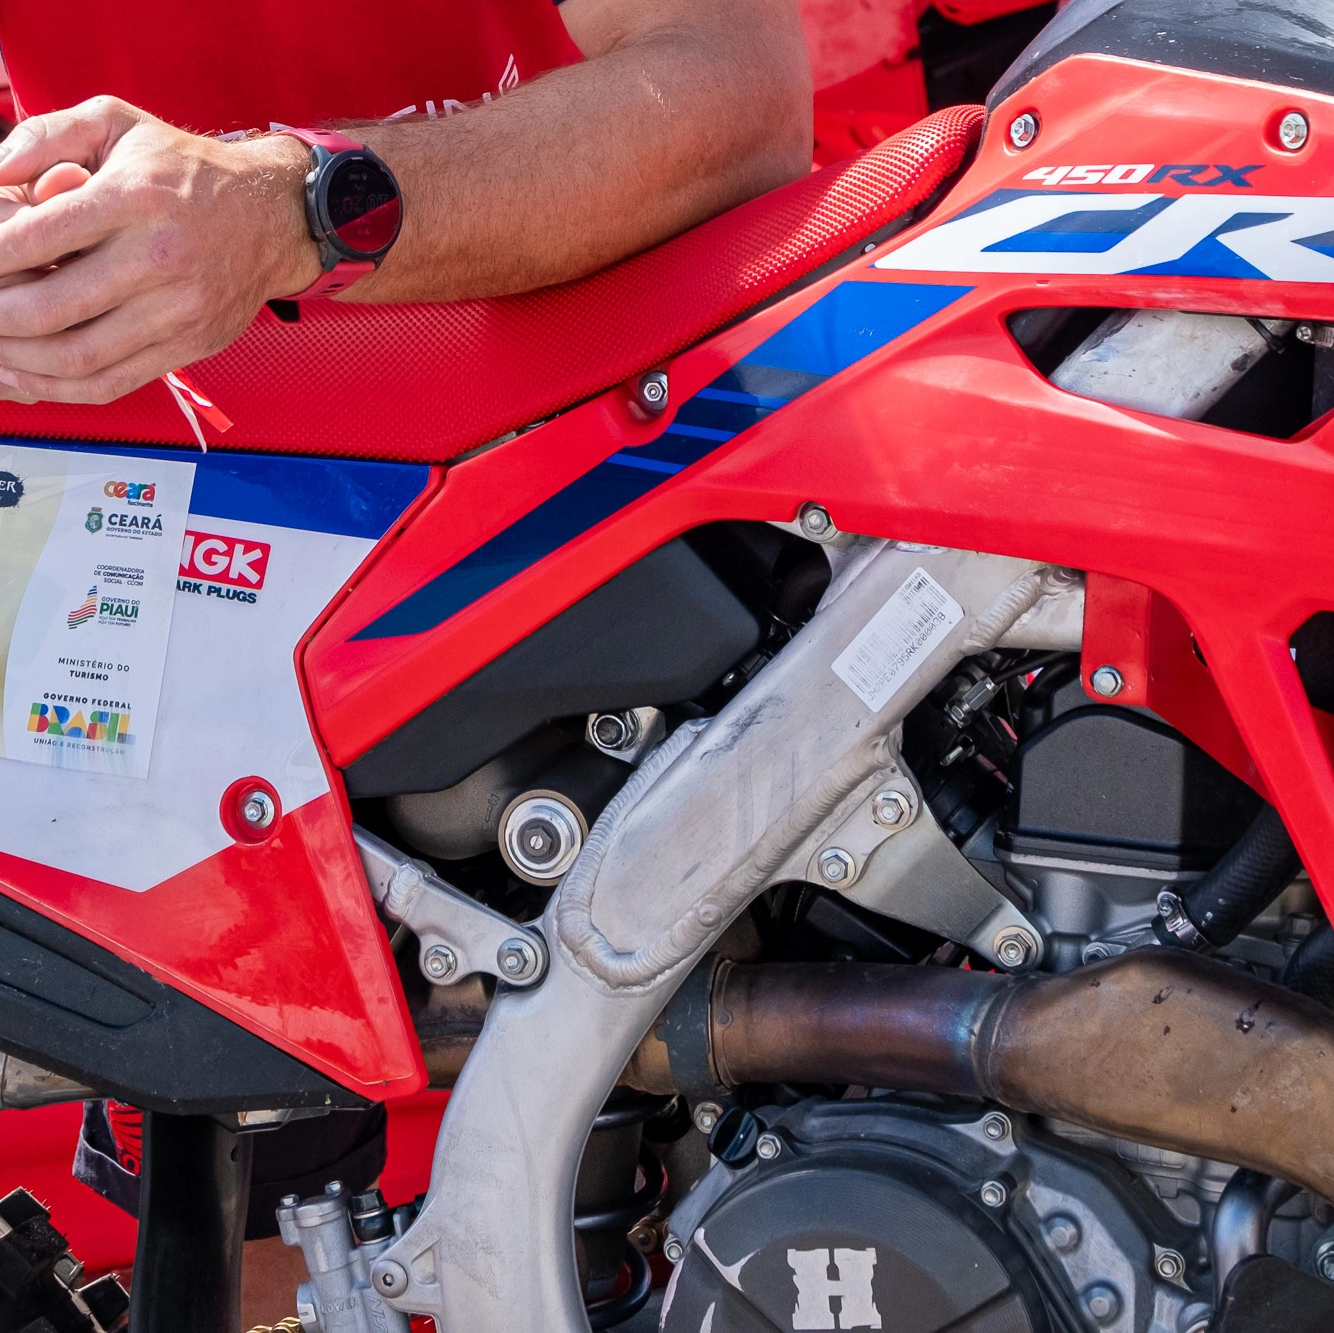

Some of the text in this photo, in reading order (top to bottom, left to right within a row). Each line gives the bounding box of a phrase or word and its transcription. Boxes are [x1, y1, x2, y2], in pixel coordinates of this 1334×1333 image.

[1021, 163, 1267, 188] 450RX
[104, 480, 156, 502] ceará
[108, 513, 163, 531] CEARÁ
[96, 564, 144, 574] COORDENADORIA
[101, 596, 130, 605] GOVERNO
[176, 579, 258, 604] ARK PLUGS
[58, 657, 130, 672] MINISTÉRIO DO
[69, 670, 109, 681] TURISMO
[43, 692, 132, 710] GOVERNO FEDERAL
[27, 702, 136, 746] BRASIL
[33, 737, 57, 746] UNIÃO
[66, 742, 125, 755] RECONSTRUÇÃO
